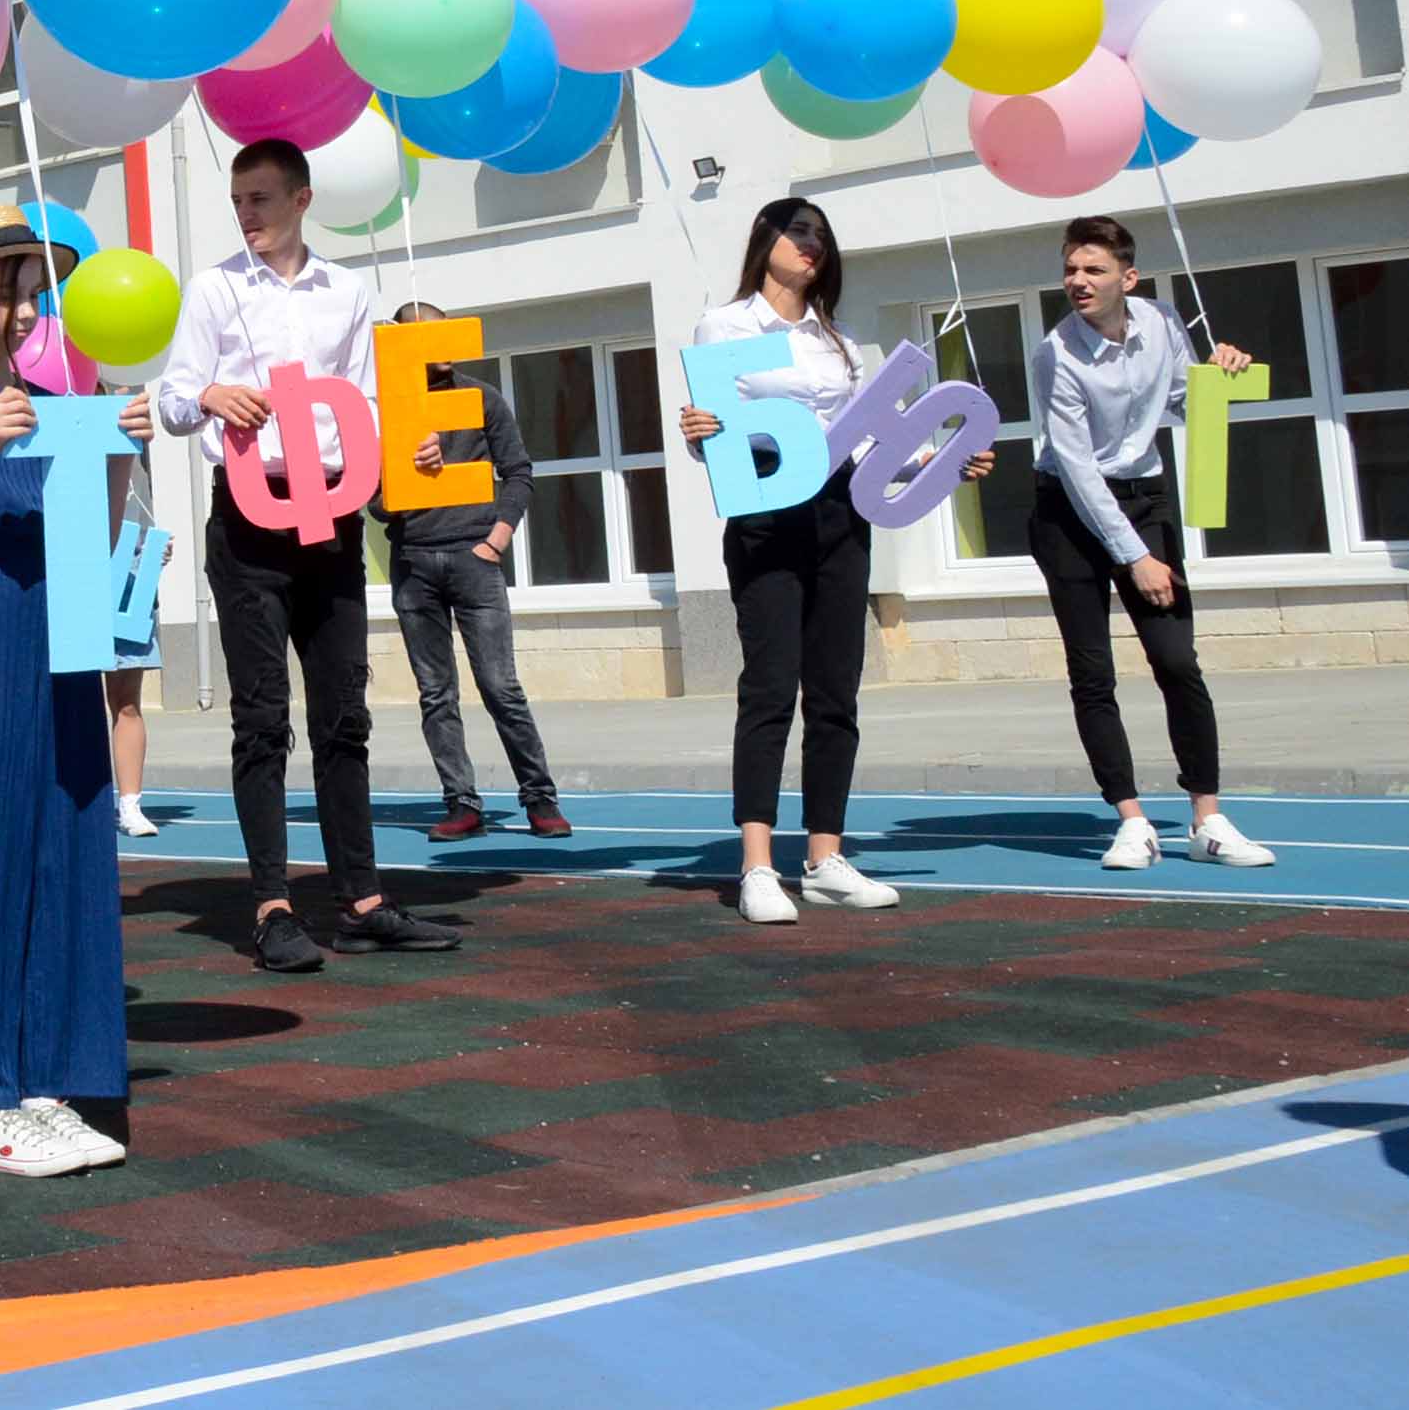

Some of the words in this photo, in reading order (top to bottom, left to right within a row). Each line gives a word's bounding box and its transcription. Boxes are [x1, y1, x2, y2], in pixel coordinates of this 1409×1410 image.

[222, 361, 382, 546] Ф
[680, 331, 830, 518] Б
[826, 338, 1000, 528] Ю
[1184, 363, 1270, 528] Г
